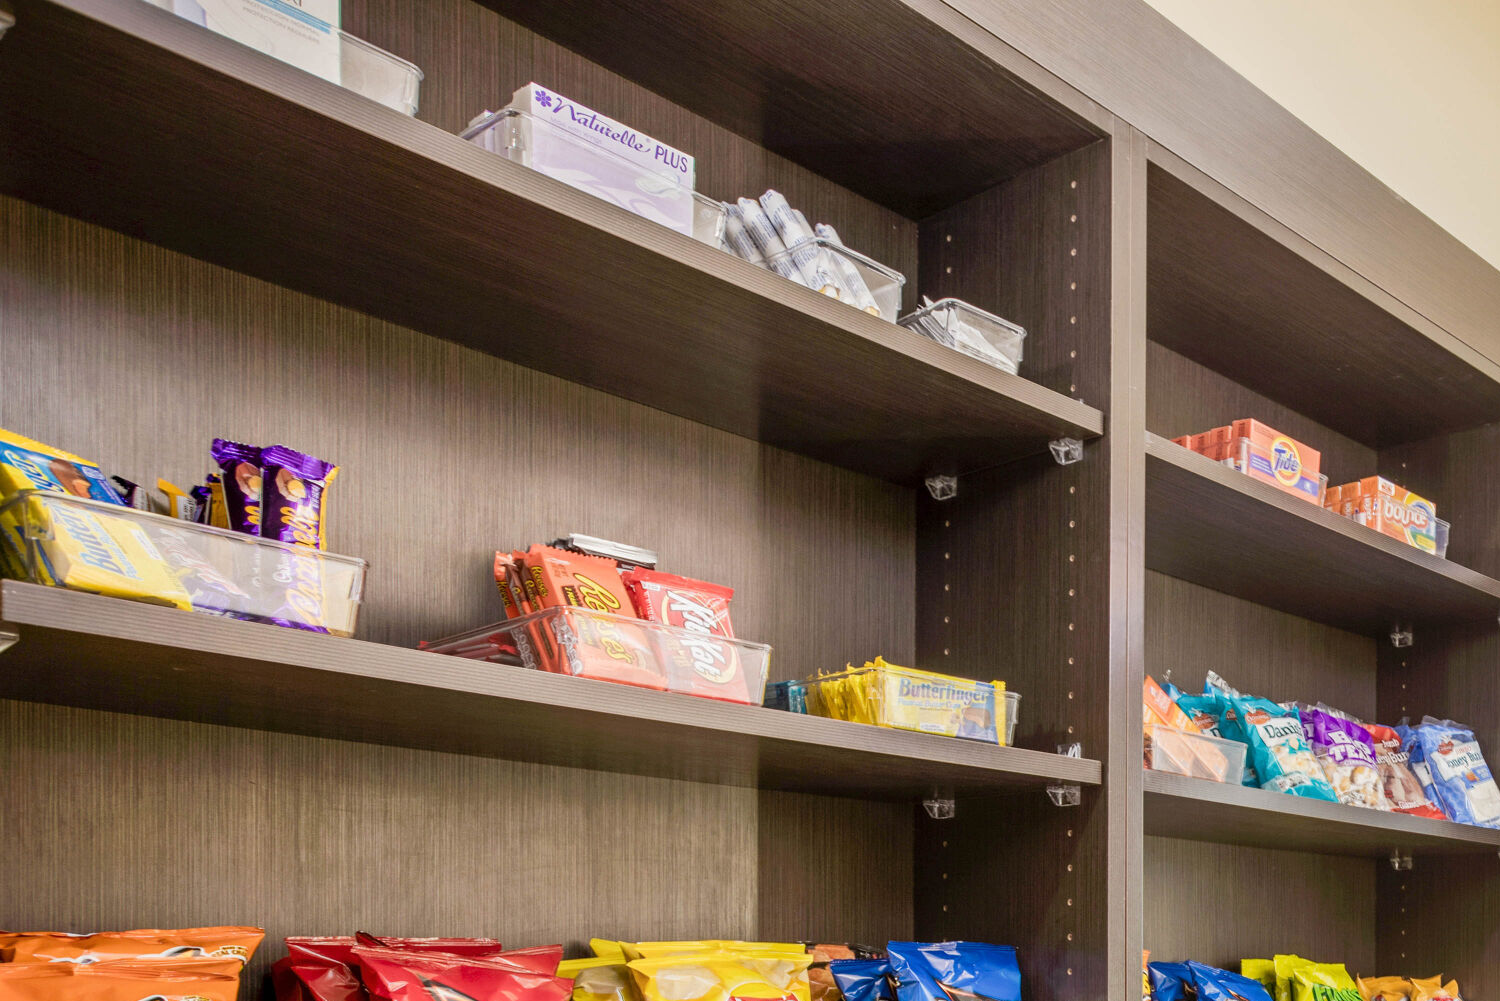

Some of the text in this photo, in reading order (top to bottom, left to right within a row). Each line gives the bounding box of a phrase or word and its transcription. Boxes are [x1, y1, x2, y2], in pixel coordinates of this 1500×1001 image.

[552, 97, 652, 154] Naturelle
[654, 145, 688, 173] PLUS
[1273, 446, 1300, 473] Tide
[898, 677, 989, 705] Butterfinger
